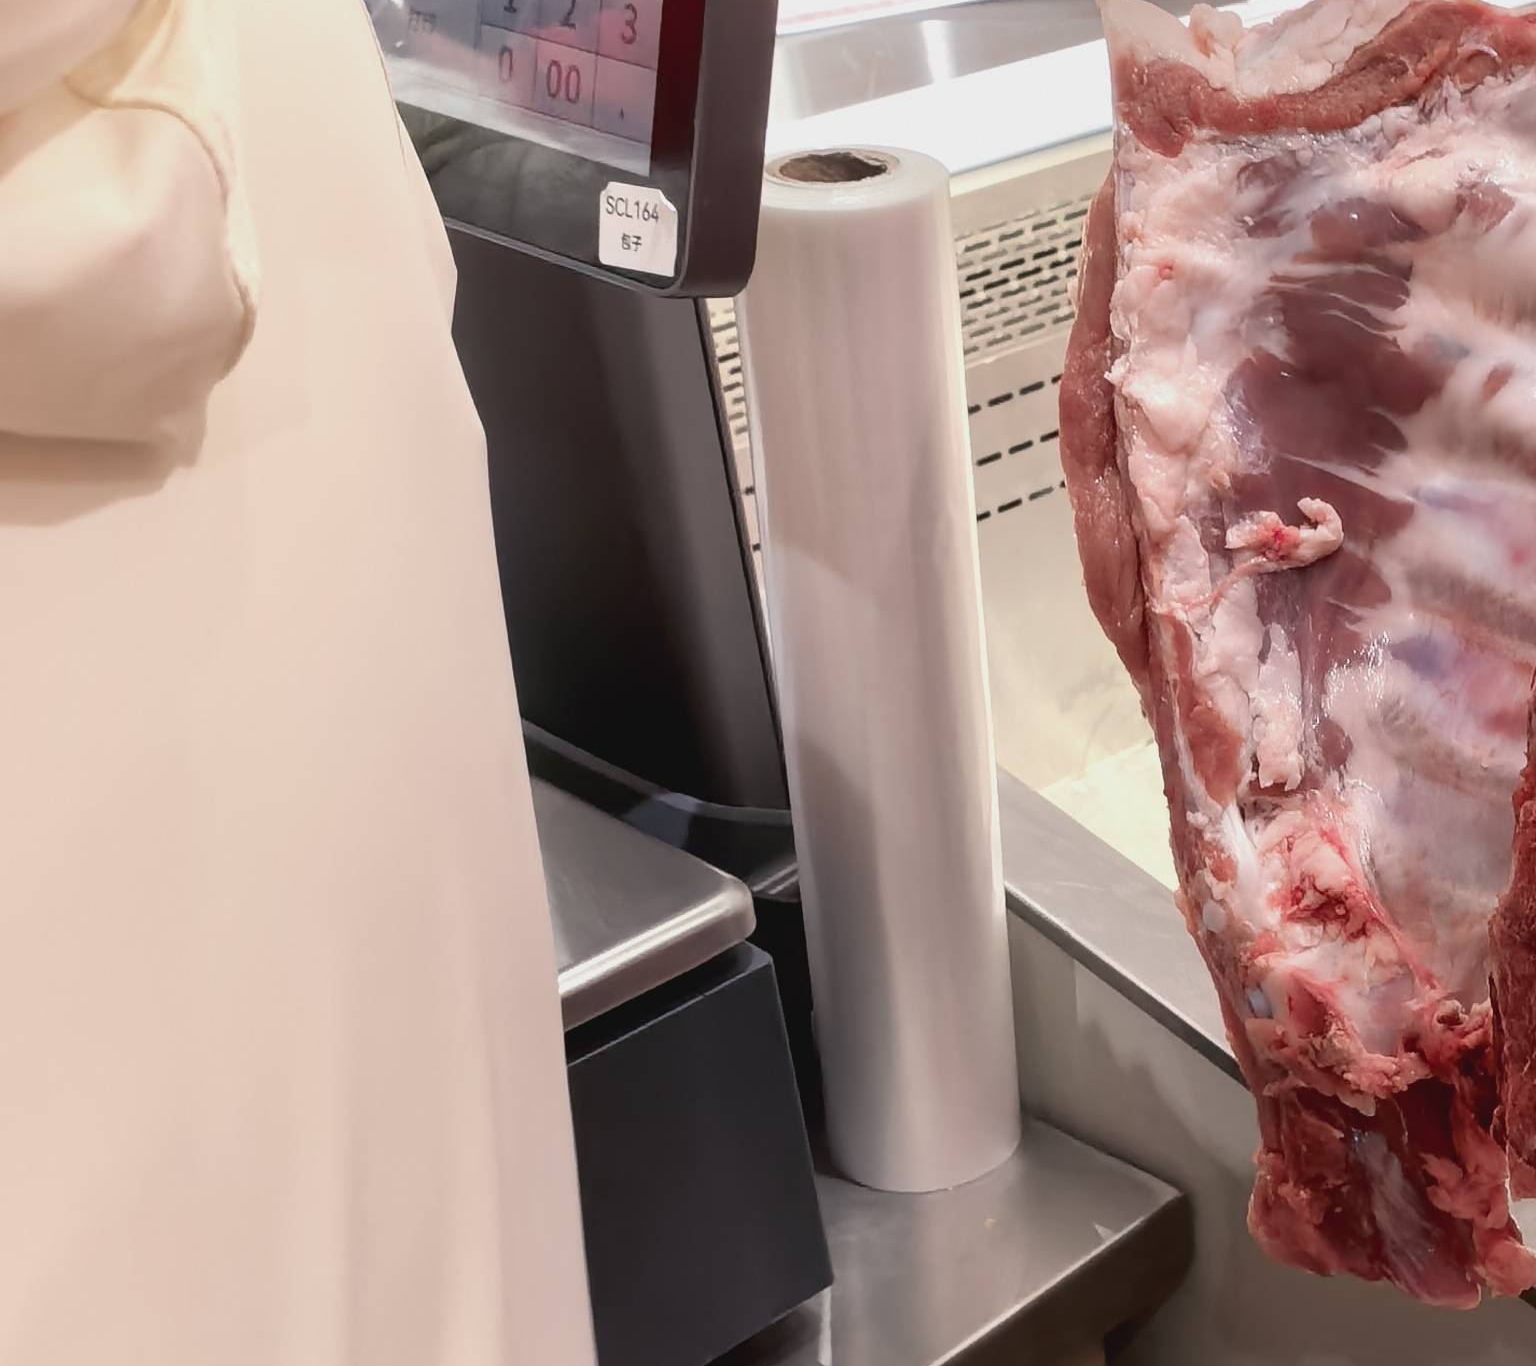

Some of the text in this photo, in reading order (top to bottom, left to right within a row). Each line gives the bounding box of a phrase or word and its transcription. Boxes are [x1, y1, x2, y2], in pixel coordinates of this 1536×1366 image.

[620, 2, 638, 45] 3
[499, 44, 514, 83] 0
[546, 59, 581, 105] 00
[605, 195, 660, 223] SCL164
